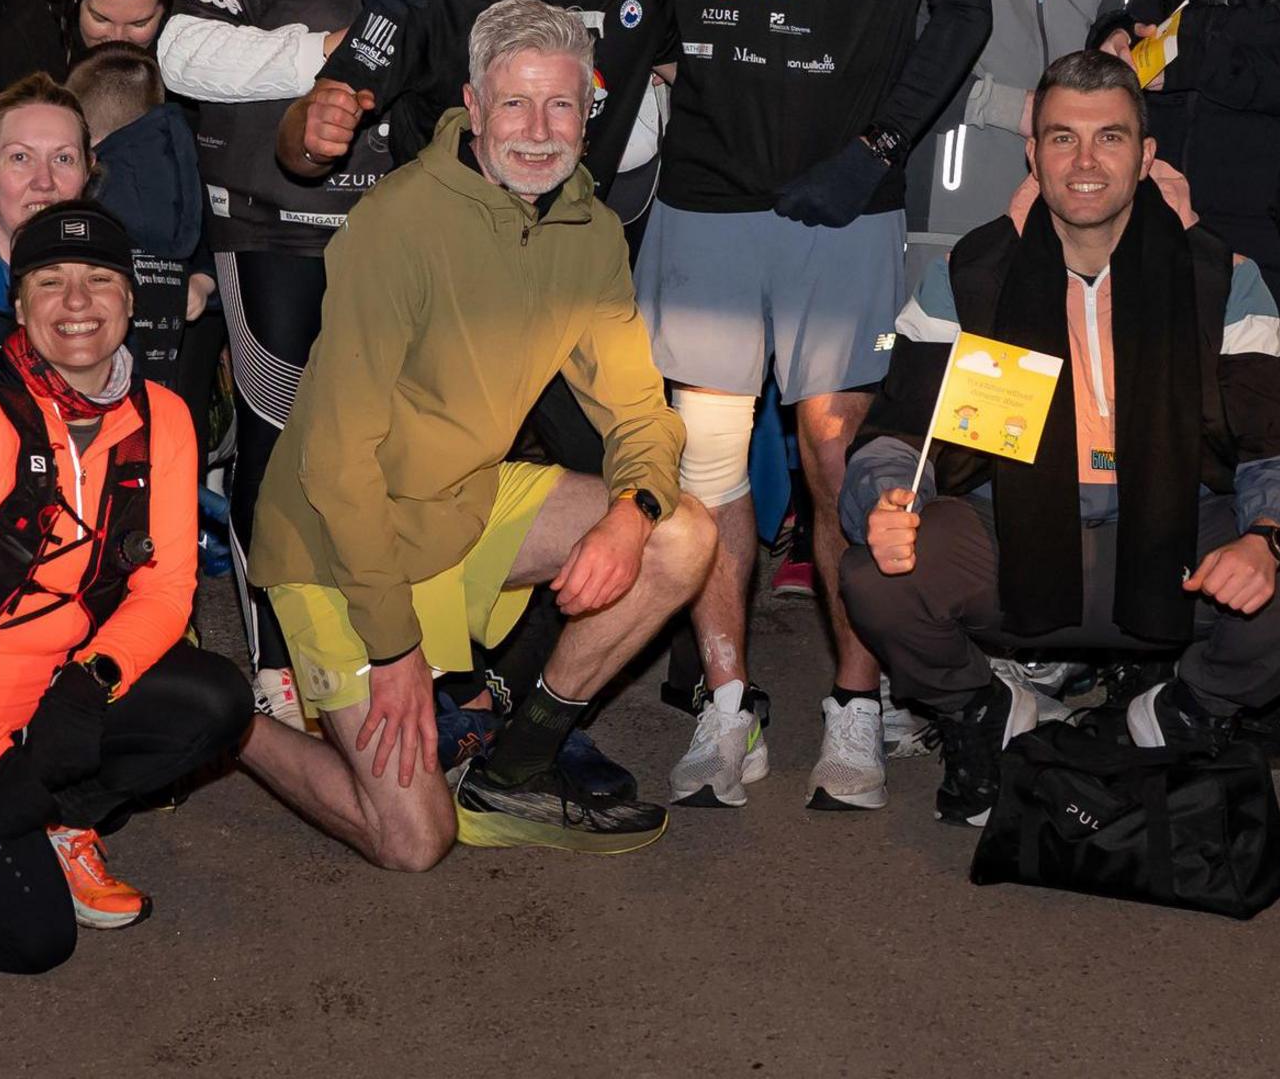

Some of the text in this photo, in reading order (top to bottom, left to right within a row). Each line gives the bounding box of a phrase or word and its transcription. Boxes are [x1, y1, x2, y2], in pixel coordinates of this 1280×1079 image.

[701, 8, 739, 21] AZURE
[733, 46, 766, 65] Melius
[802, 59, 835, 71] williams
[286, 212, 345, 225] BATHGATE
